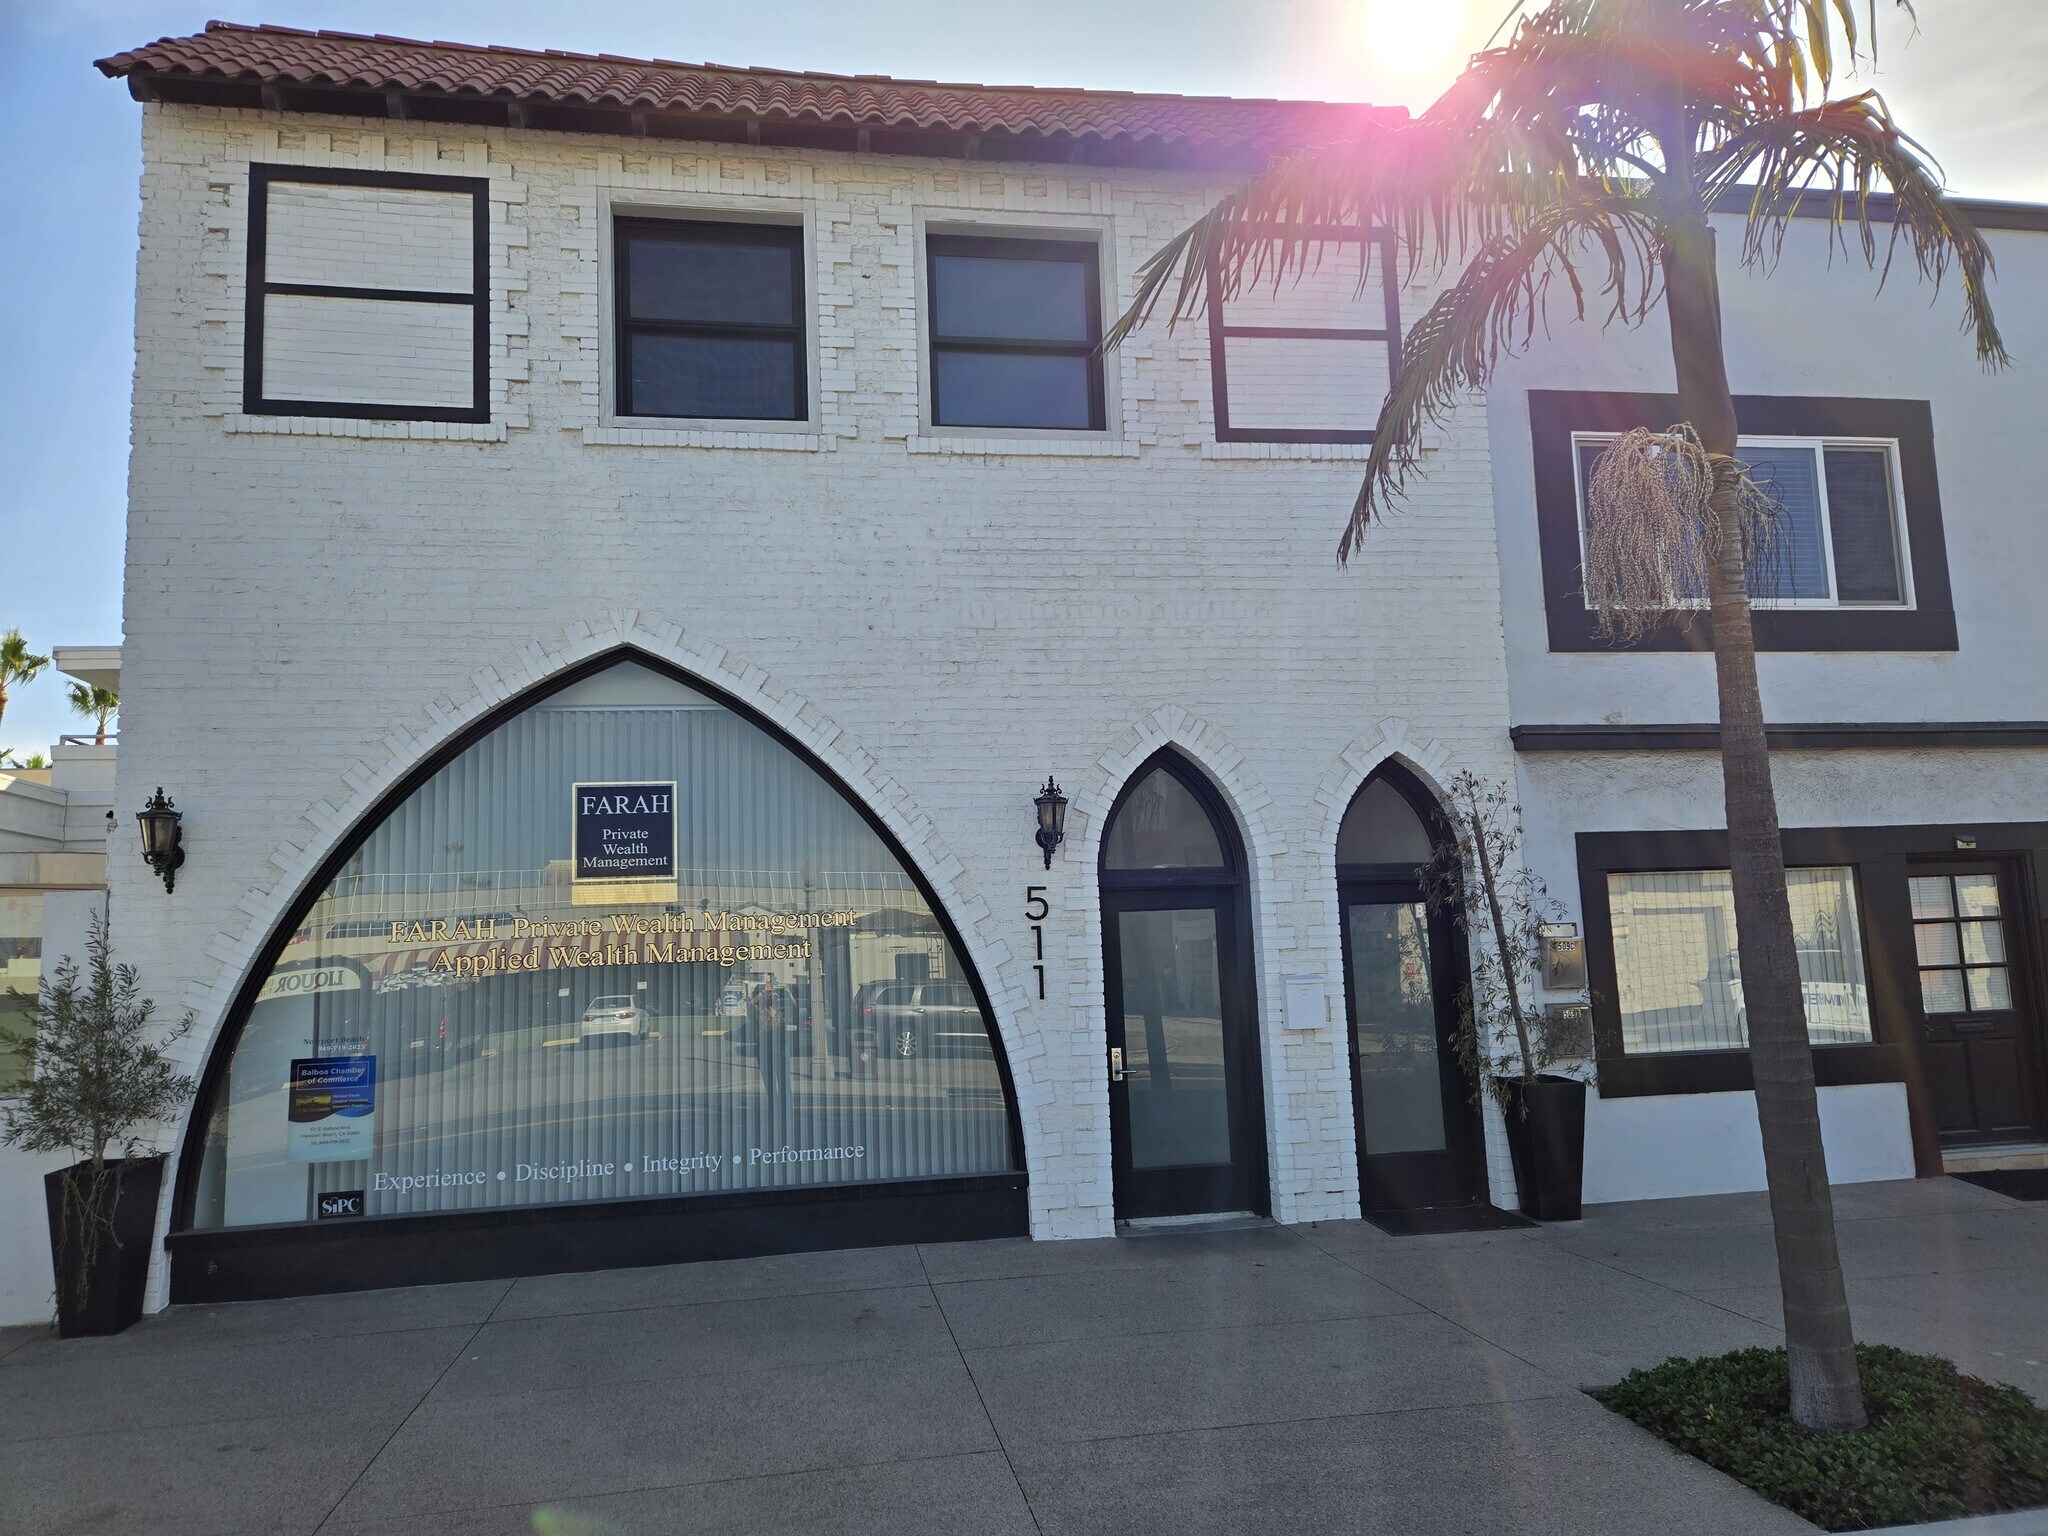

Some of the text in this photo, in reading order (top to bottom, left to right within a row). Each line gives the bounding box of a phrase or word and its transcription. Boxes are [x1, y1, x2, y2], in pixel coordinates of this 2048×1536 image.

[581, 794, 670, 815] FARAH
[602, 828, 649, 840] Private
[602, 842, 649, 855] Wealth
[583, 856, 668, 870] Management
[388, 908, 857, 943] FARAH Private Wealth Management
[1025, 886, 1049, 1000] 511
[430, 939, 812, 978] Applied Wealth Management
[303, 1037, 339, 1045] Newport
[318, 1044, 366, 1052] 949-719-2625
[301, 1067, 365, 1076] Balboa Chamber
[317, 1075, 359, 1083] Commerce
[373, 1145, 865, 1194] Experience Discipline Integrity Performance
